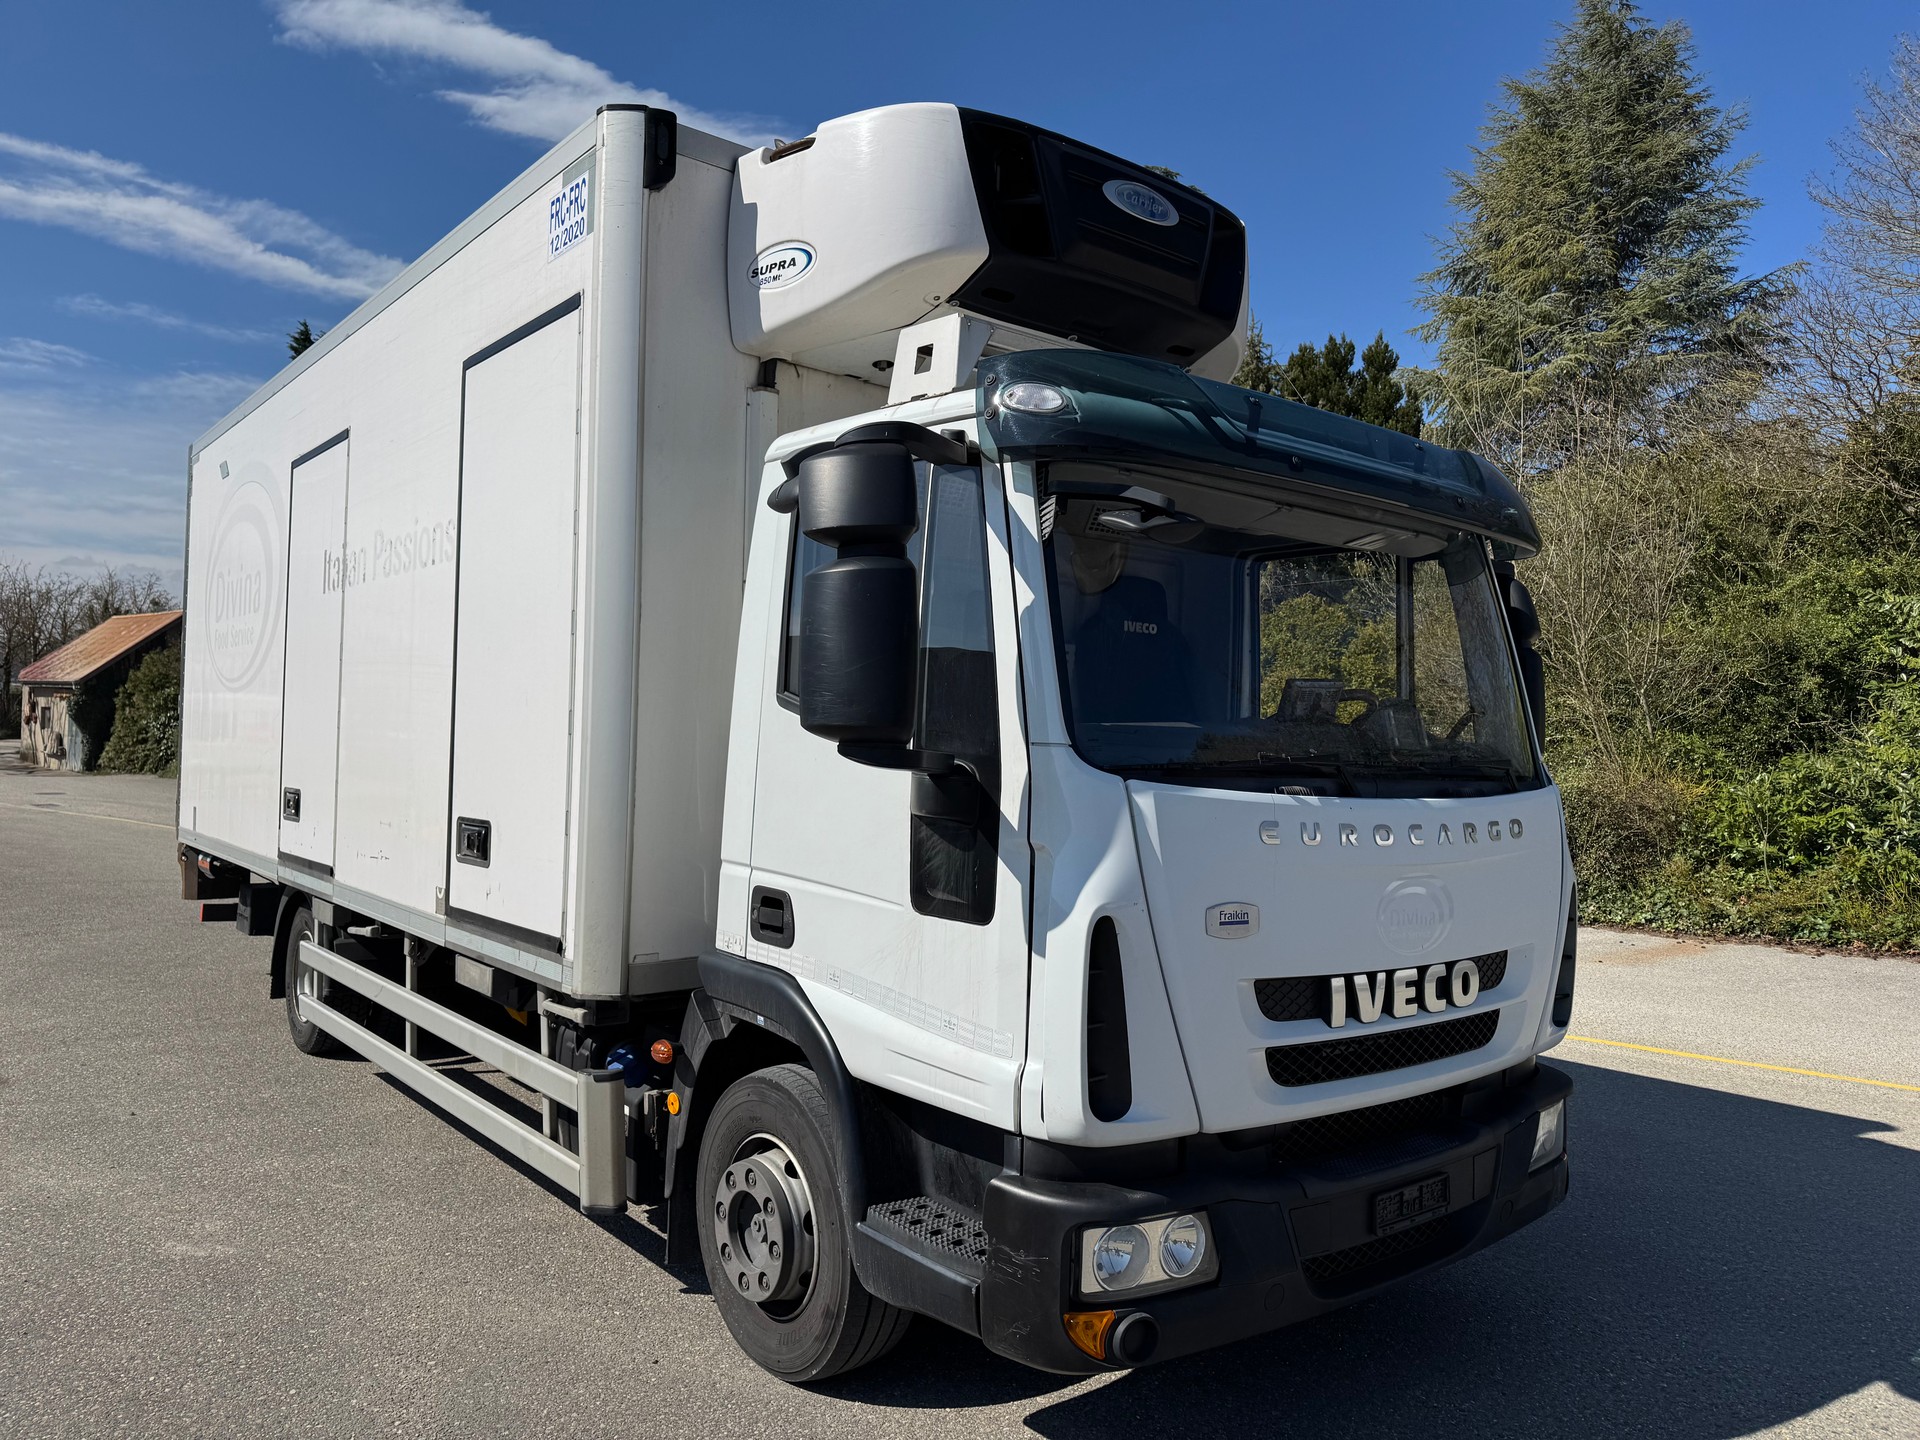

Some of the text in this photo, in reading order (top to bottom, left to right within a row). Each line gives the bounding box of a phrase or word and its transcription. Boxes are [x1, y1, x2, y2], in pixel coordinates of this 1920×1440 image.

[549, 177, 587, 234] FRC-FRC
[1124, 190, 1163, 214] Carrier
[550, 217, 585, 254] 12/2020
[751, 257, 797, 279] SUPRA
[215, 562, 262, 623] Divina
[1123, 620, 1158, 635] IVECO
[1258, 818, 1524, 847] EUROCARGO
[1219, 909, 1249, 921] Fraikin
[1329, 959, 1480, 1029] IVECO
